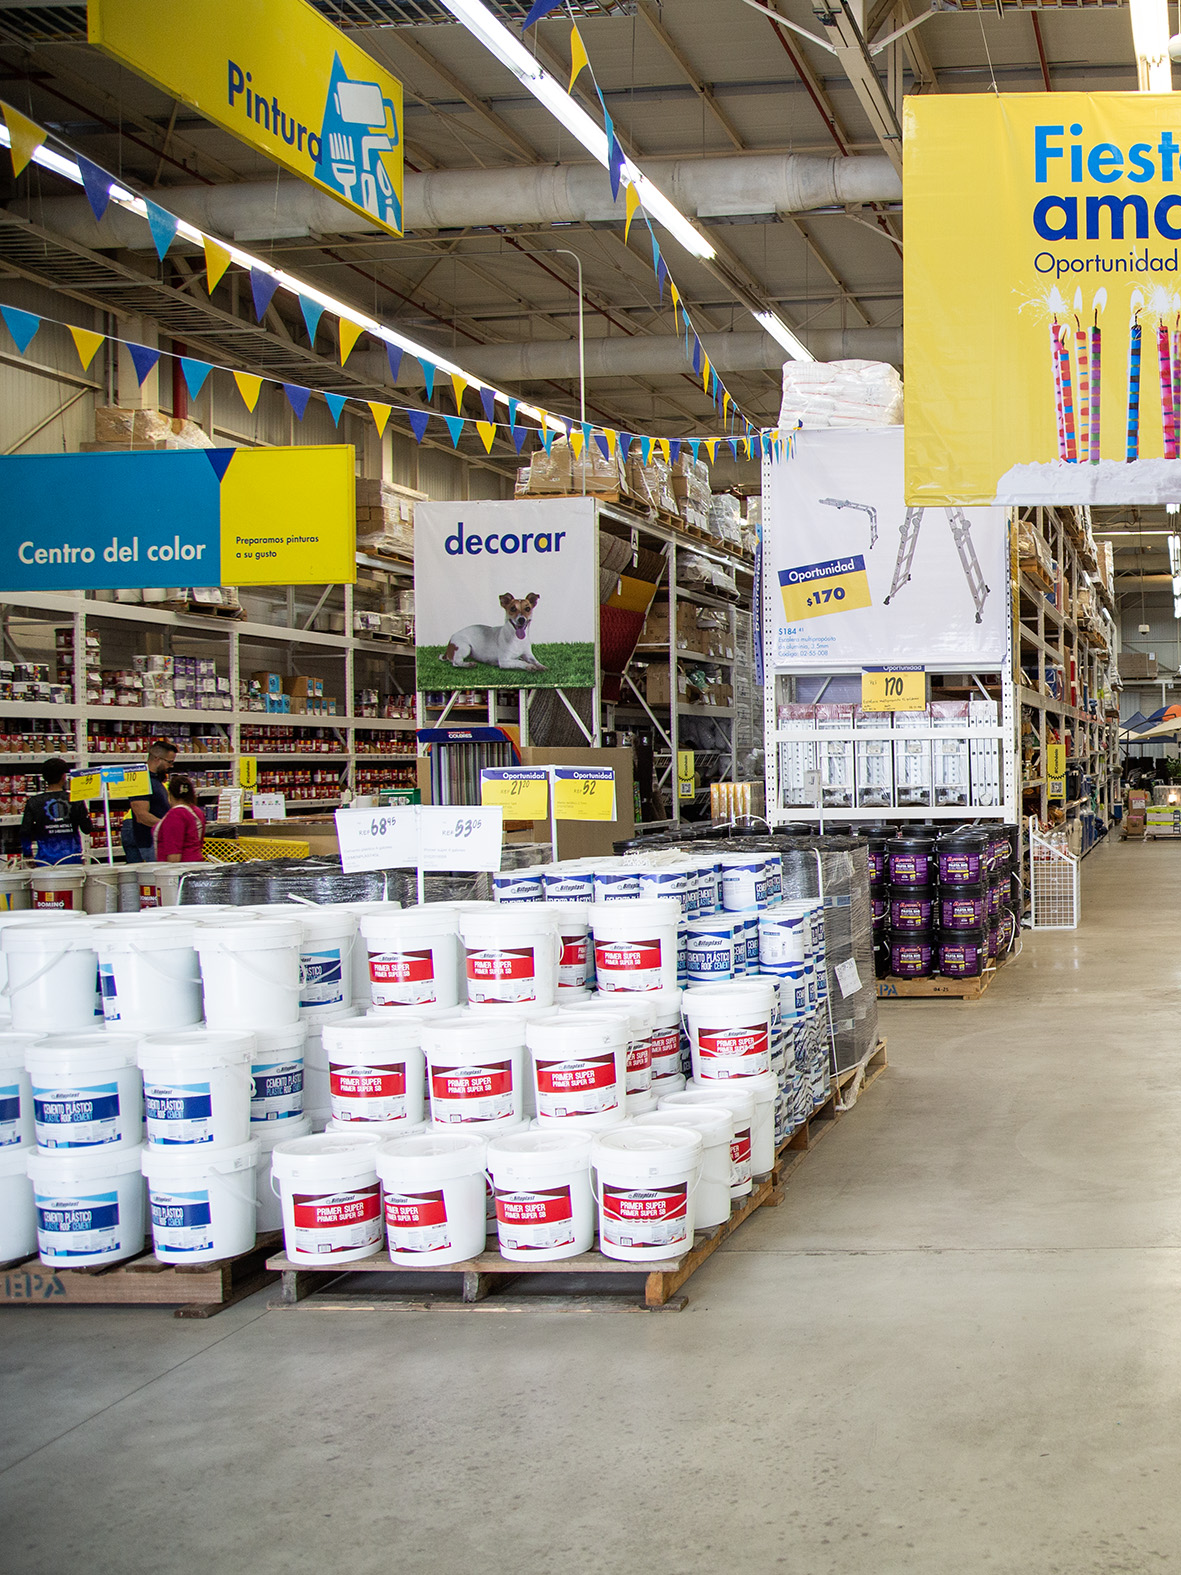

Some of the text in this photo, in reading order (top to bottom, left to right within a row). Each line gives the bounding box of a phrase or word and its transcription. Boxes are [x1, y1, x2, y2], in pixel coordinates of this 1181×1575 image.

[227, 59, 324, 165] Pintura
[1034, 249, 1179, 279] Oportunidad
[236, 534, 320, 547] Preparamos pinturas
[445, 522, 566, 556] decorar
[18, 535, 207, 564] Centro del color
[244, 551, 253, 559] su
[255, 549, 278, 561] gusto
[788, 558, 855, 583] Oportunidad
[806, 586, 846, 607] $170
[778, 627, 797, 636] $184
[502, 772, 545, 784] Oportunidad
[573, 771, 613, 783] Oportunidad
[510, 780, 522, 796] 21
[582, 780, 597, 796] 52
[370, 817, 387, 837] 68
[454, 819, 472, 838] 53
[560, 883, 585, 892] Bituplast
[697, 939, 723, 948] Bituplast
[604, 952, 622, 960] PRIMER
[706, 950, 730, 961] PLÁSTICO
[701, 960, 730, 970] ROOF CEMENT
[561, 1062, 585, 1070] Bituplast
[340, 1077, 382, 1086] PRIMER SUPER
[447, 1077, 492, 1087] PRIMER SUPER
[552, 1070, 595, 1082] PRIMER SUPER
[266, 1078, 286, 1088] CEMENTO
[55, 1092, 80, 1100] Bituplast
[267, 1087, 283, 1097] PLASTIC
[43, 1100, 93, 1114] CEMENTO PLÁSTICO
[160, 1098, 184, 1111] PLÁSTICO
[60, 1113, 71, 1123] ROOF
[72, 1111, 93, 1122] CEMENT
[167, 1110, 184, 1119] CEMENT
[55, 1200, 80, 1208] Bituplast
[316, 1202, 364, 1217] PRIMER SUPER
[504, 1203, 546, 1214] PRIMER SUPER
[620, 1200, 666, 1209] PRIMER SUPER
[43, 1209, 92, 1222] CEMENTO PLÁSTICO
[161, 1205, 184, 1218] PLÁSTICO
[60, 1221, 71, 1231] ROOF
[72, 1220, 92, 1230] CEMENT
[167, 1217, 184, 1227] CEMENT
[5, 1273, 68, 1299] EPA
